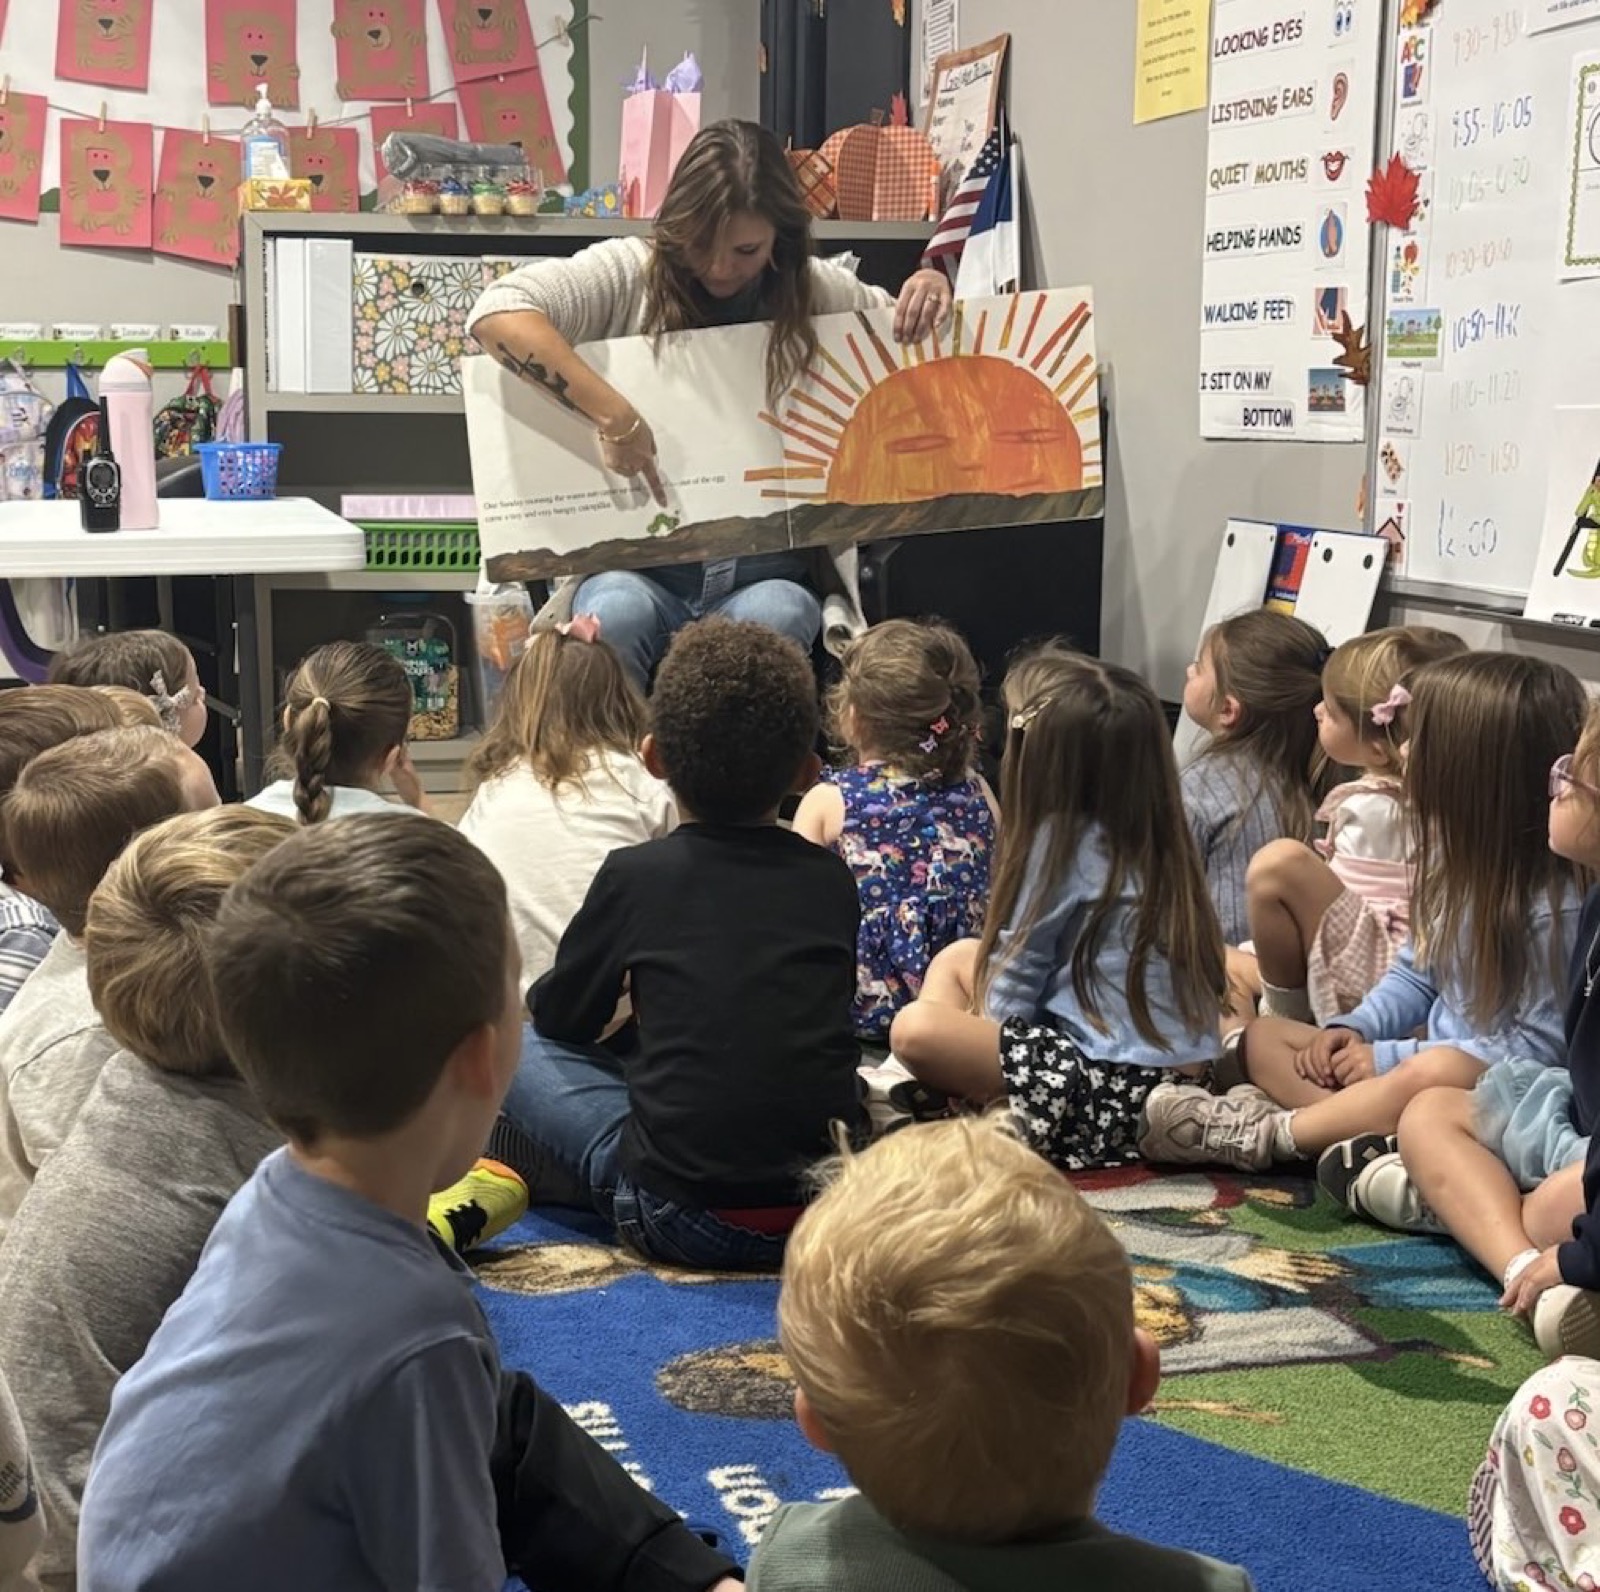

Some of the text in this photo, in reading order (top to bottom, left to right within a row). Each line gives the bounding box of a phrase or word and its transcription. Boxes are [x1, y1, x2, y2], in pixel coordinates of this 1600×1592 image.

[1214, 26, 1268, 58] LOOKING
[1272, 18, 1303, 44] EYES
[1211, 86, 1314, 124] LISTENING EARS
[1210, 158, 1307, 190] QUIET MOUTHS
[1206, 225, 1302, 252] HELPING HANDS
[1204, 299, 1294, 323] WALKING FEET
[1200, 371, 1272, 390] I SIT ON MY
[1243, 407, 1294, 427] BOTTOM
